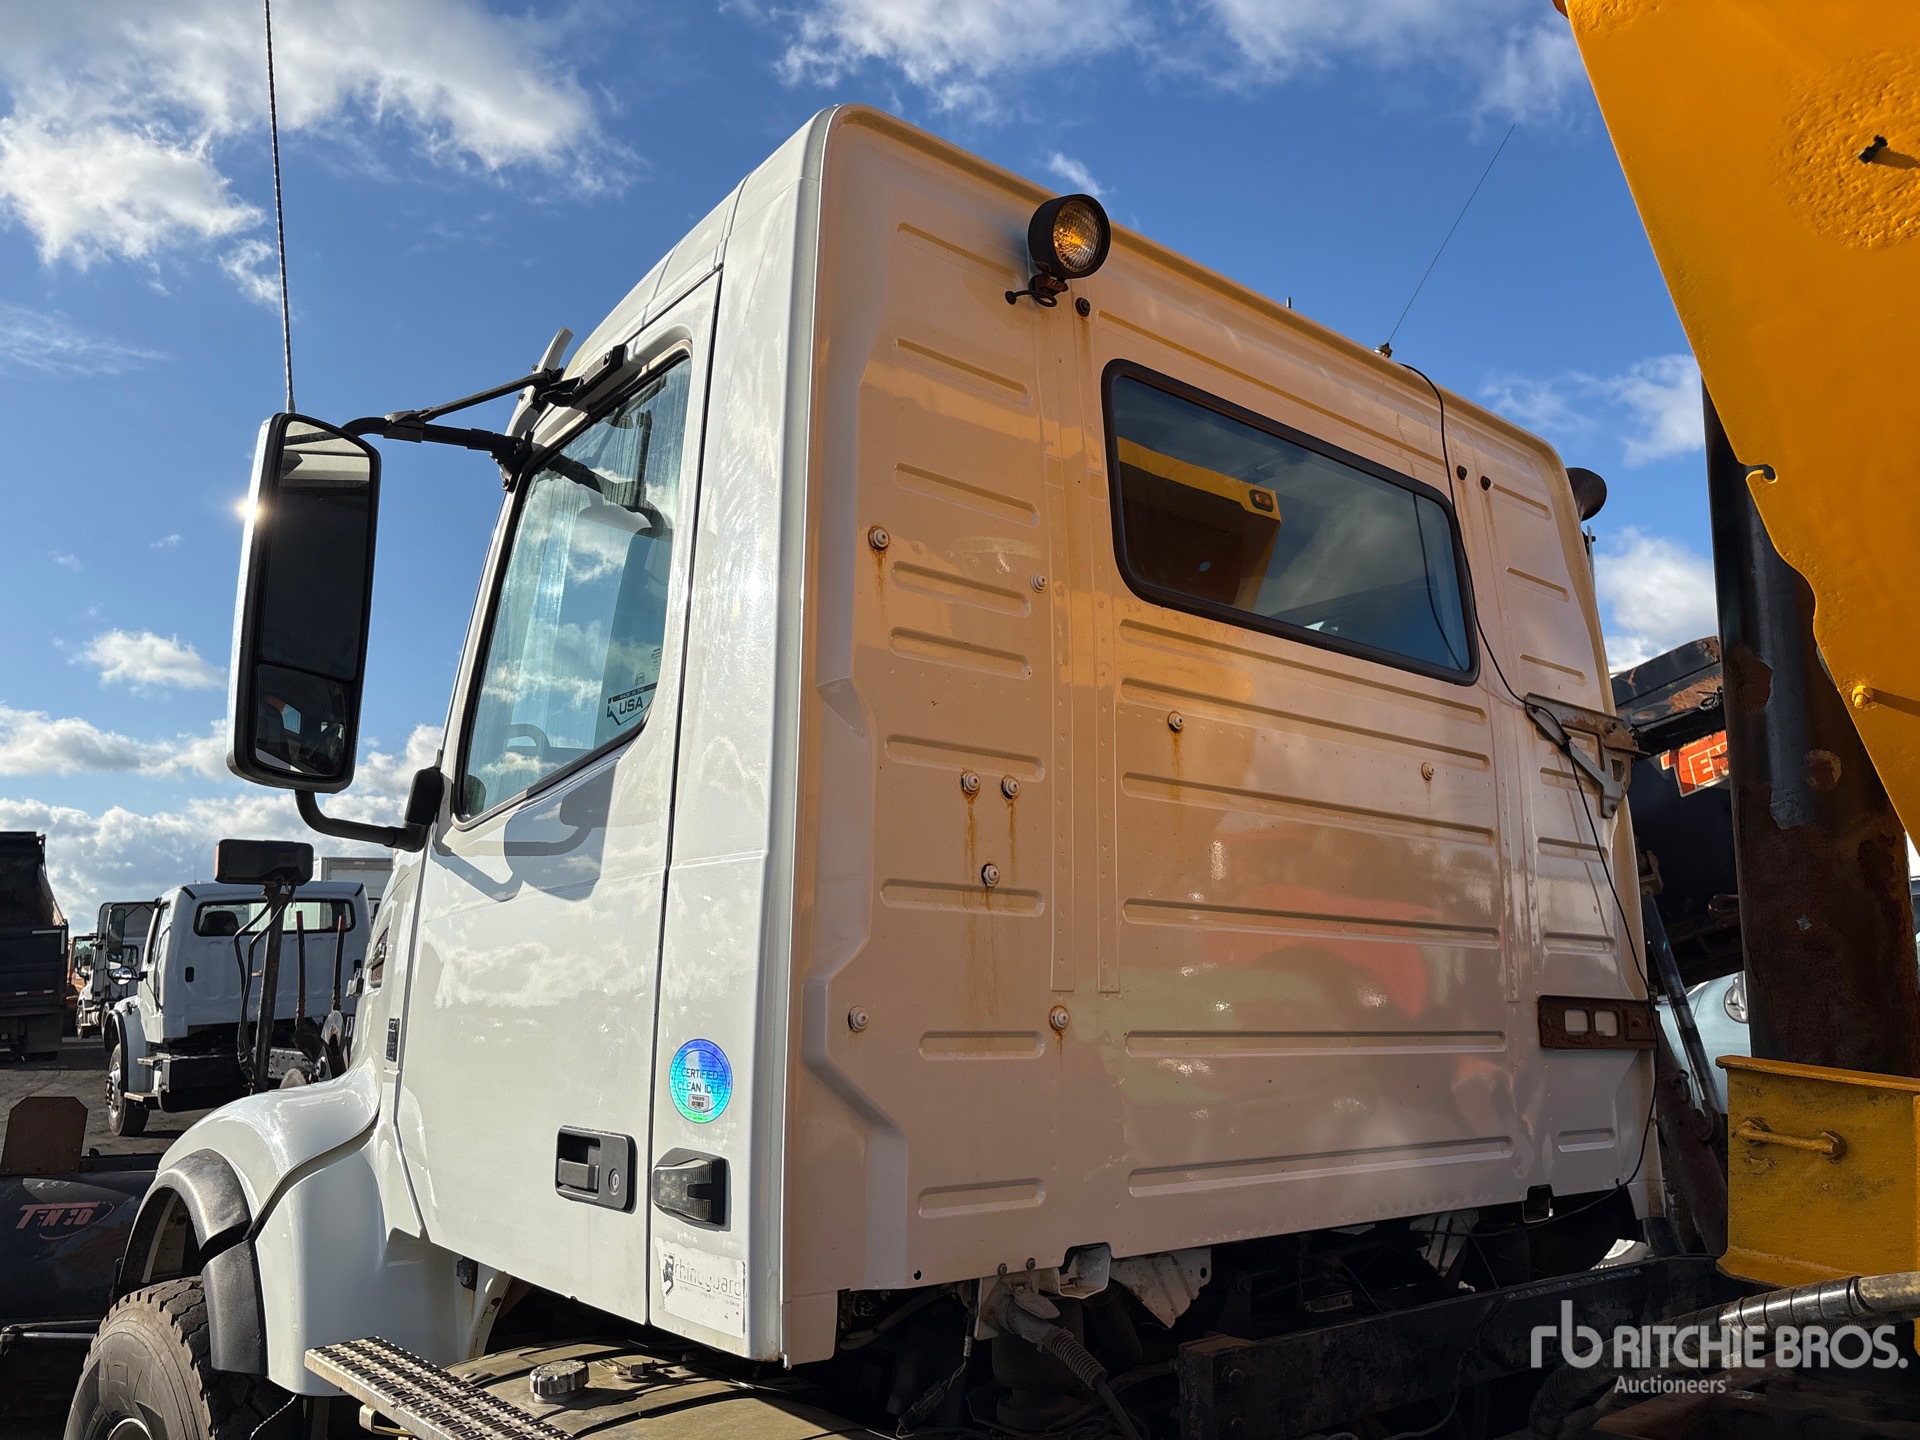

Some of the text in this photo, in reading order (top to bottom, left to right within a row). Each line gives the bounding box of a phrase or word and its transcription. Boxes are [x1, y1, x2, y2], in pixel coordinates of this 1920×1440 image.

[619, 696, 643, 715] USA
[681, 1067, 719, 1080] CERTIFIED
[677, 1080, 722, 1095] CLEAN IDLE
